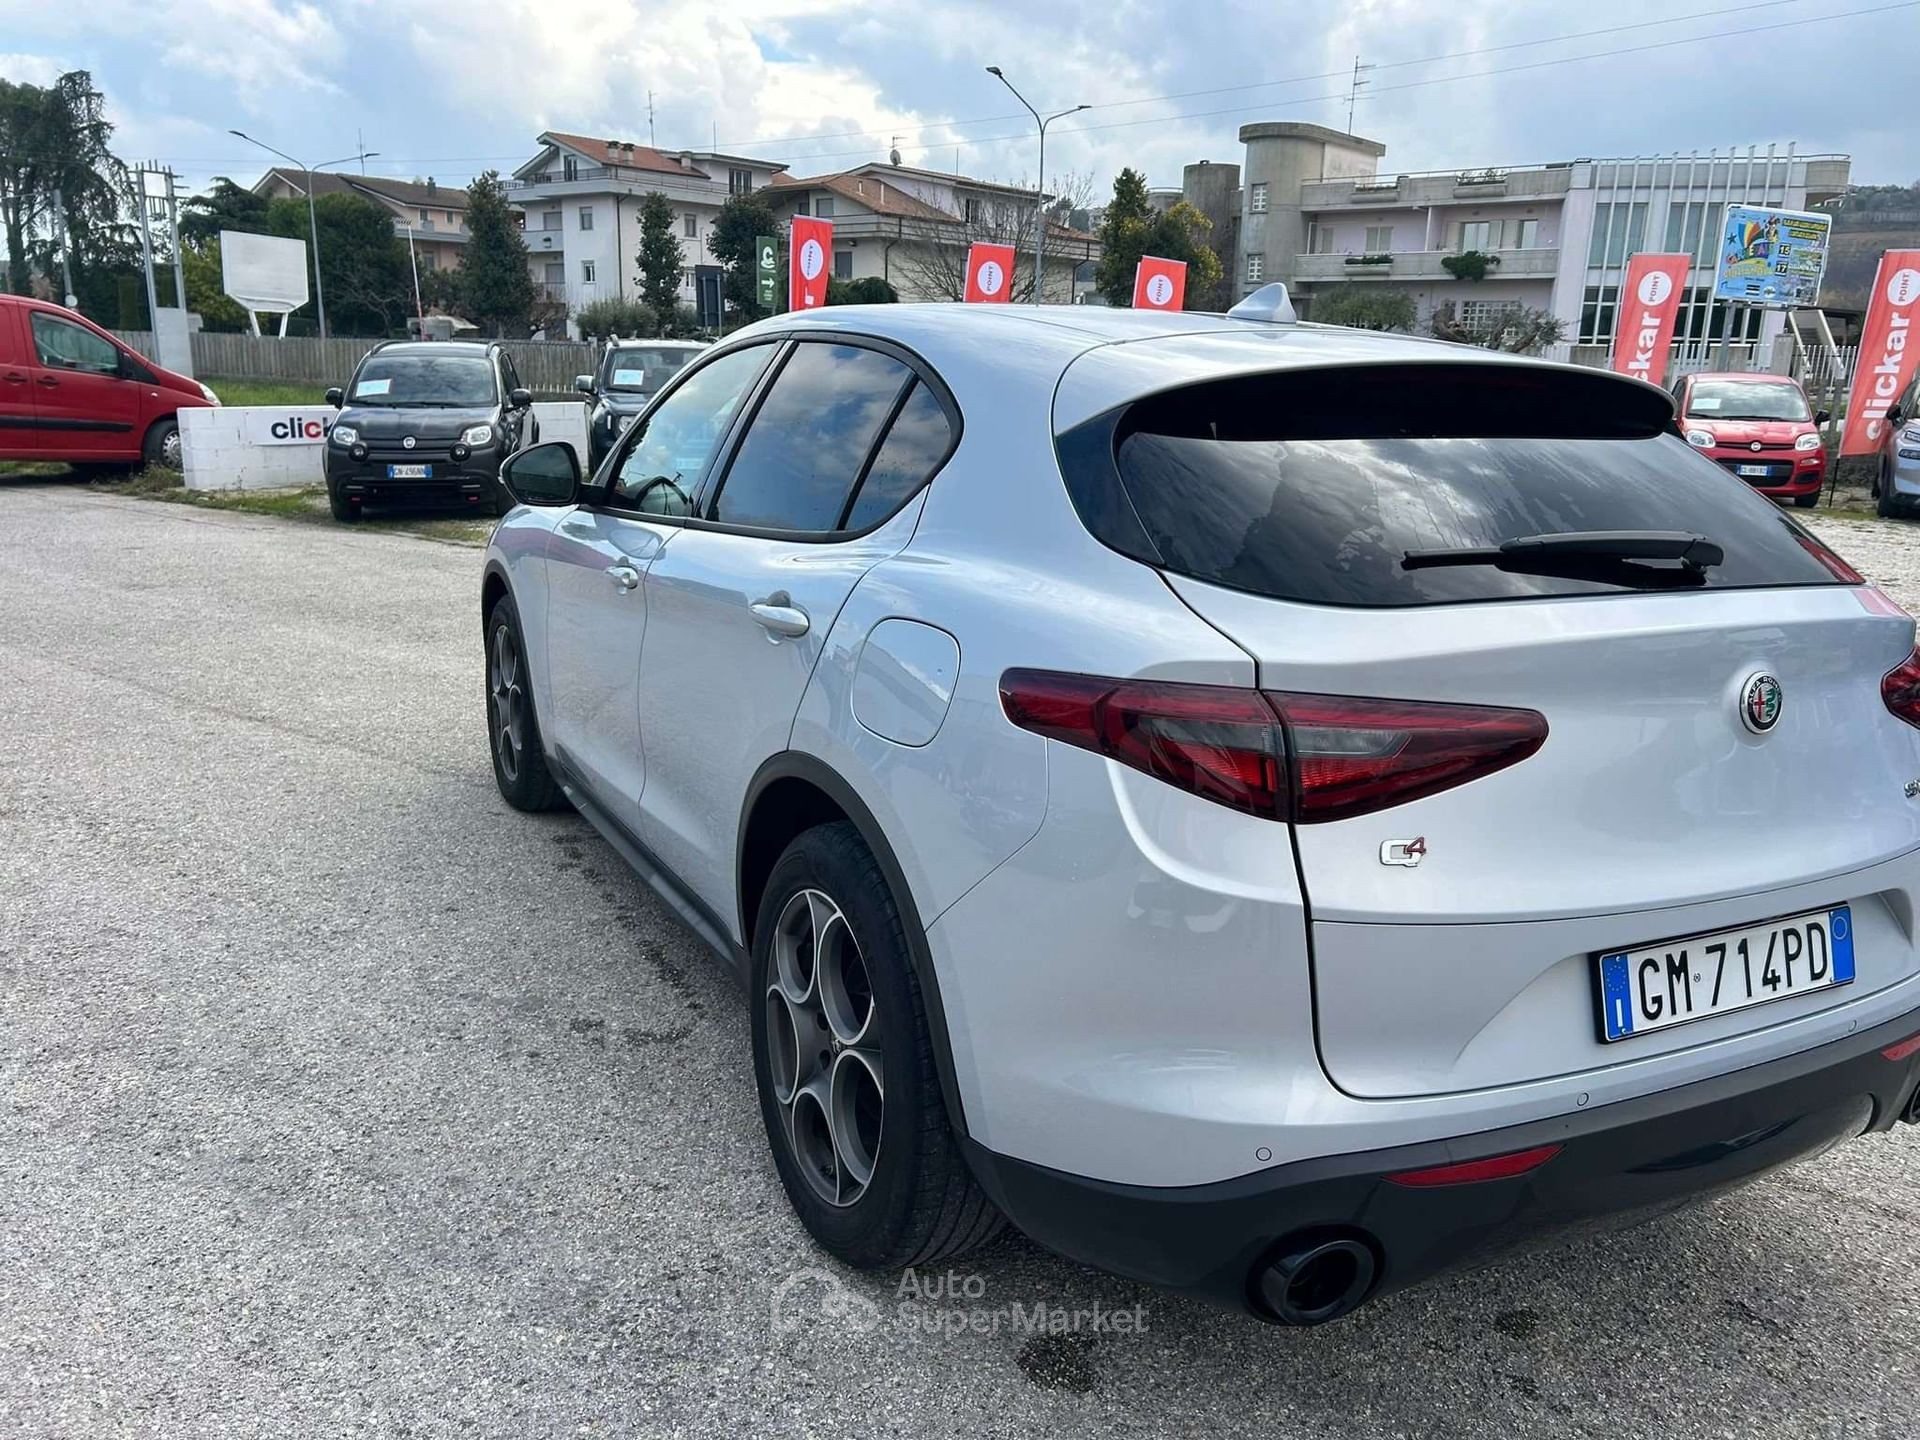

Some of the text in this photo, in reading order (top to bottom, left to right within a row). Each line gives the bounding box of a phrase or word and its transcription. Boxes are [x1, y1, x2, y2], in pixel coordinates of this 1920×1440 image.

[1156, 278, 1164, 302] POINT
[1649, 275, 1661, 302] POINT
[1898, 273, 1911, 302] POINT
[1862, 312, 1911, 440] clickar
